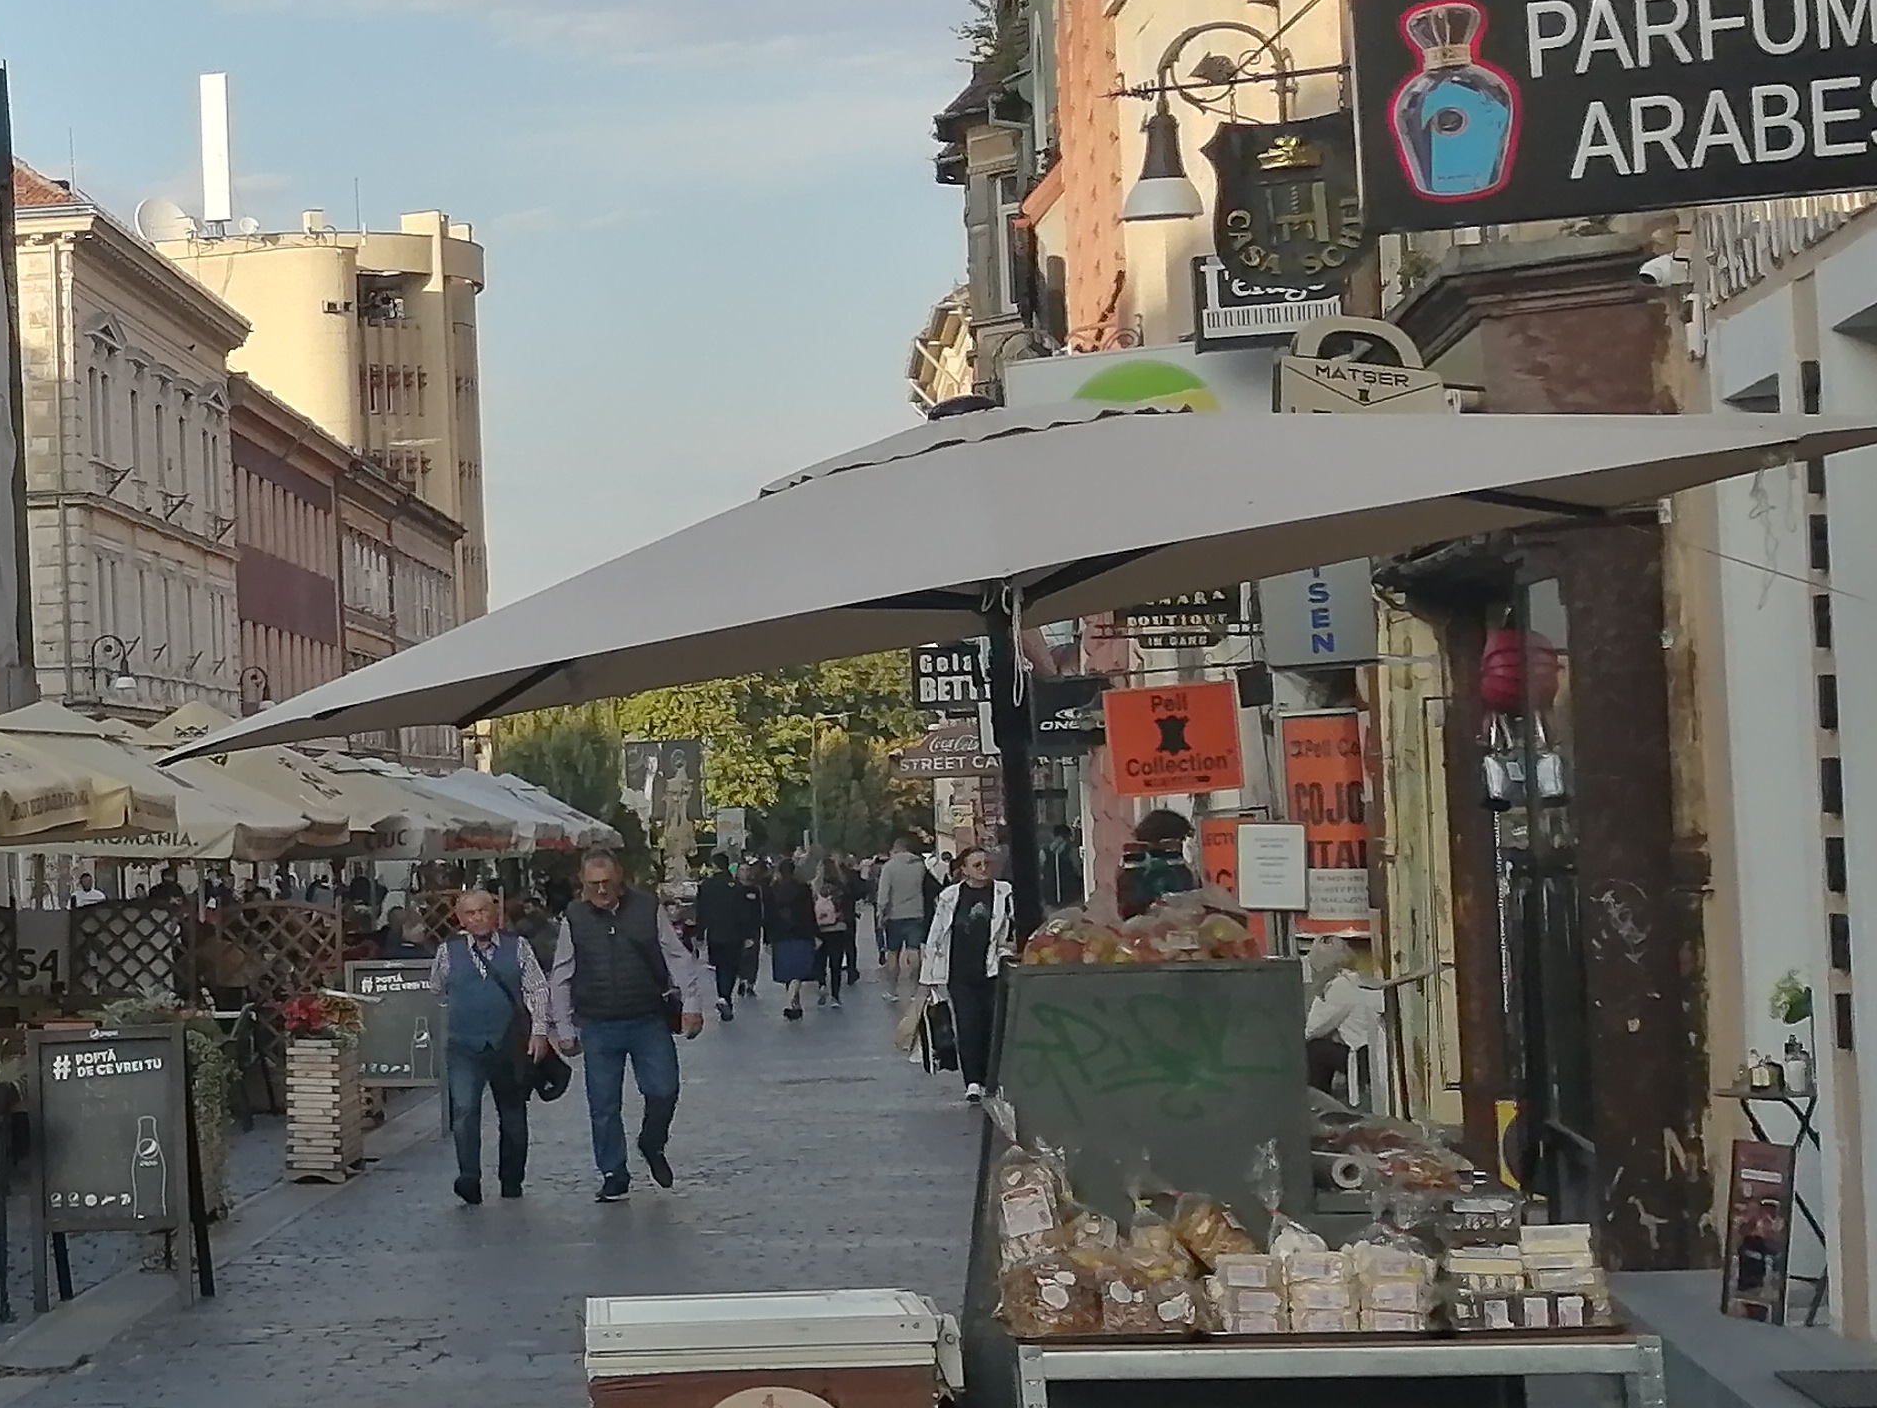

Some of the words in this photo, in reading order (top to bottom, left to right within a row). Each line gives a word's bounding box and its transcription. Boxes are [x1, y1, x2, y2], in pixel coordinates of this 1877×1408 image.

[1570, 77, 1877, 180] ARABE
[1315, 364, 1410, 388] MATSER
[900, 755, 967, 771] STREET
[1126, 753, 1227, 777] Collection
[17, 949, 60, 982] 54
[76, 1065, 95, 1078] DE
[95, 1063, 115, 1076] CE
[115, 1059, 144, 1074] VREI
[146, 1057, 163, 1071] TU
